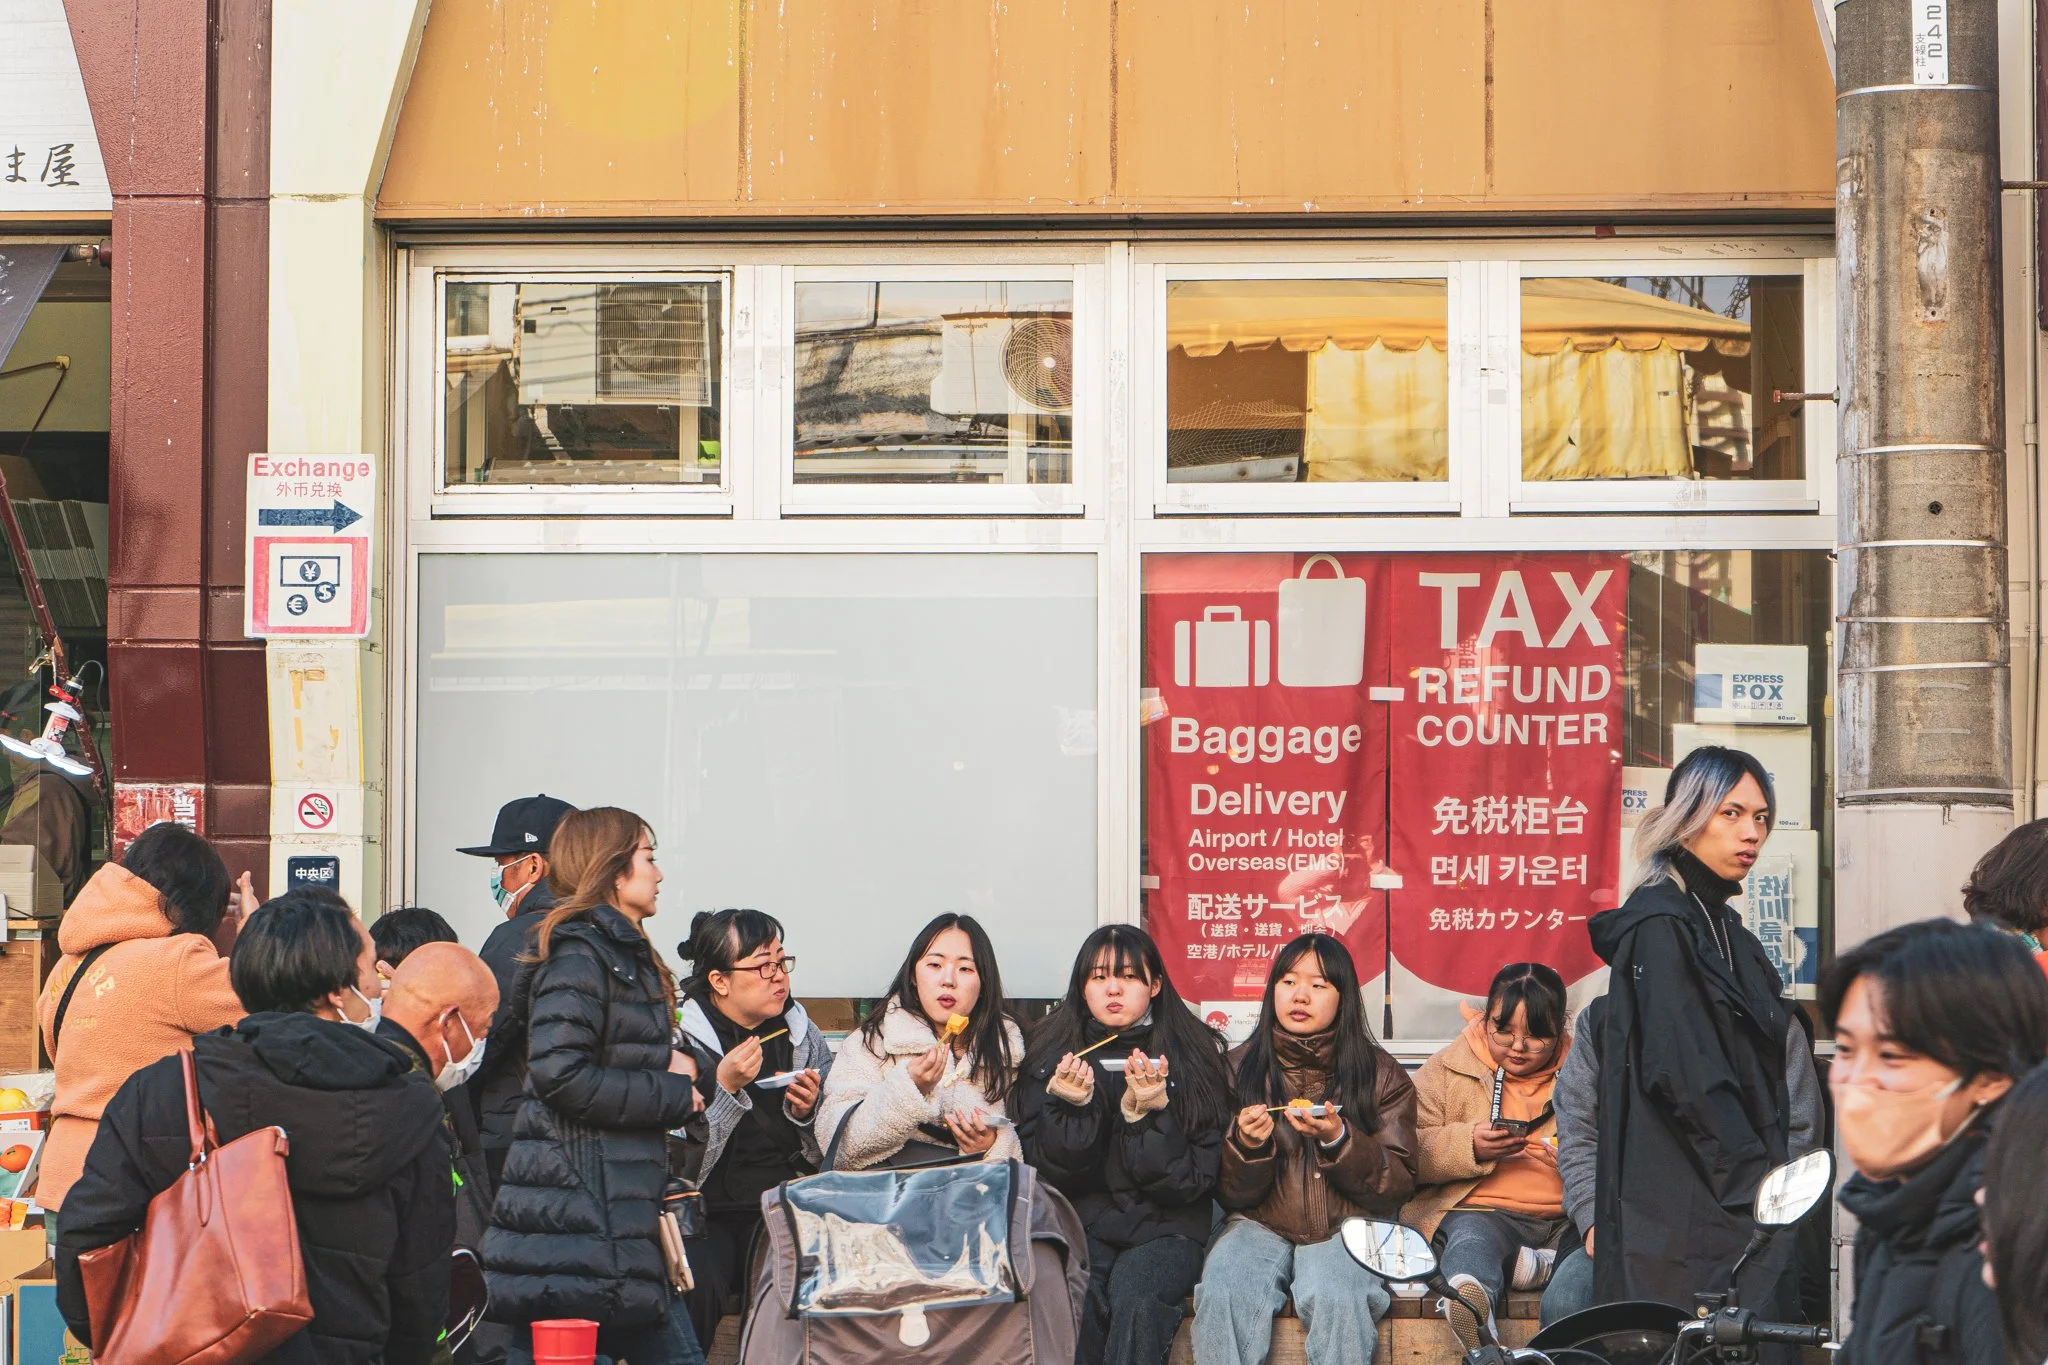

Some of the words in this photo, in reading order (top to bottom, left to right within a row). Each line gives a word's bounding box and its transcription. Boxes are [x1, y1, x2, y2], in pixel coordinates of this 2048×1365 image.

[1915, 33, 1926, 67] 支線柱
[253, 457, 370, 482] Exchange
[276, 482, 343, 498] 外币兑换
[1419, 570, 1614, 648] TAX
[1418, 665, 1612, 704] REFUND
[1732, 674, 1784, 684] EXPRESS
[1732, 684, 1784, 700] BOX
[1170, 717, 1362, 764] Baggage
[1417, 713, 1609, 747] COUNTER
[1190, 783, 1348, 824] Delivery
[1622, 789, 1648, 797] PRESS
[1623, 796, 1647, 808] OX
[1431, 796, 1589, 835] 免税柜台
[1188, 829, 1267, 852] Airport
[1287, 828, 1344, 848] Hotel
[295, 867, 335, 880] 中央区
[1188, 853, 1345, 875] Overseas(EMS)
[1431, 855, 1489, 885] 면세
[1499, 854, 1587, 885] 카운터
[1187, 893, 1344, 920] 配送サービス
[1429, 908, 1587, 931] 免税カウンター
